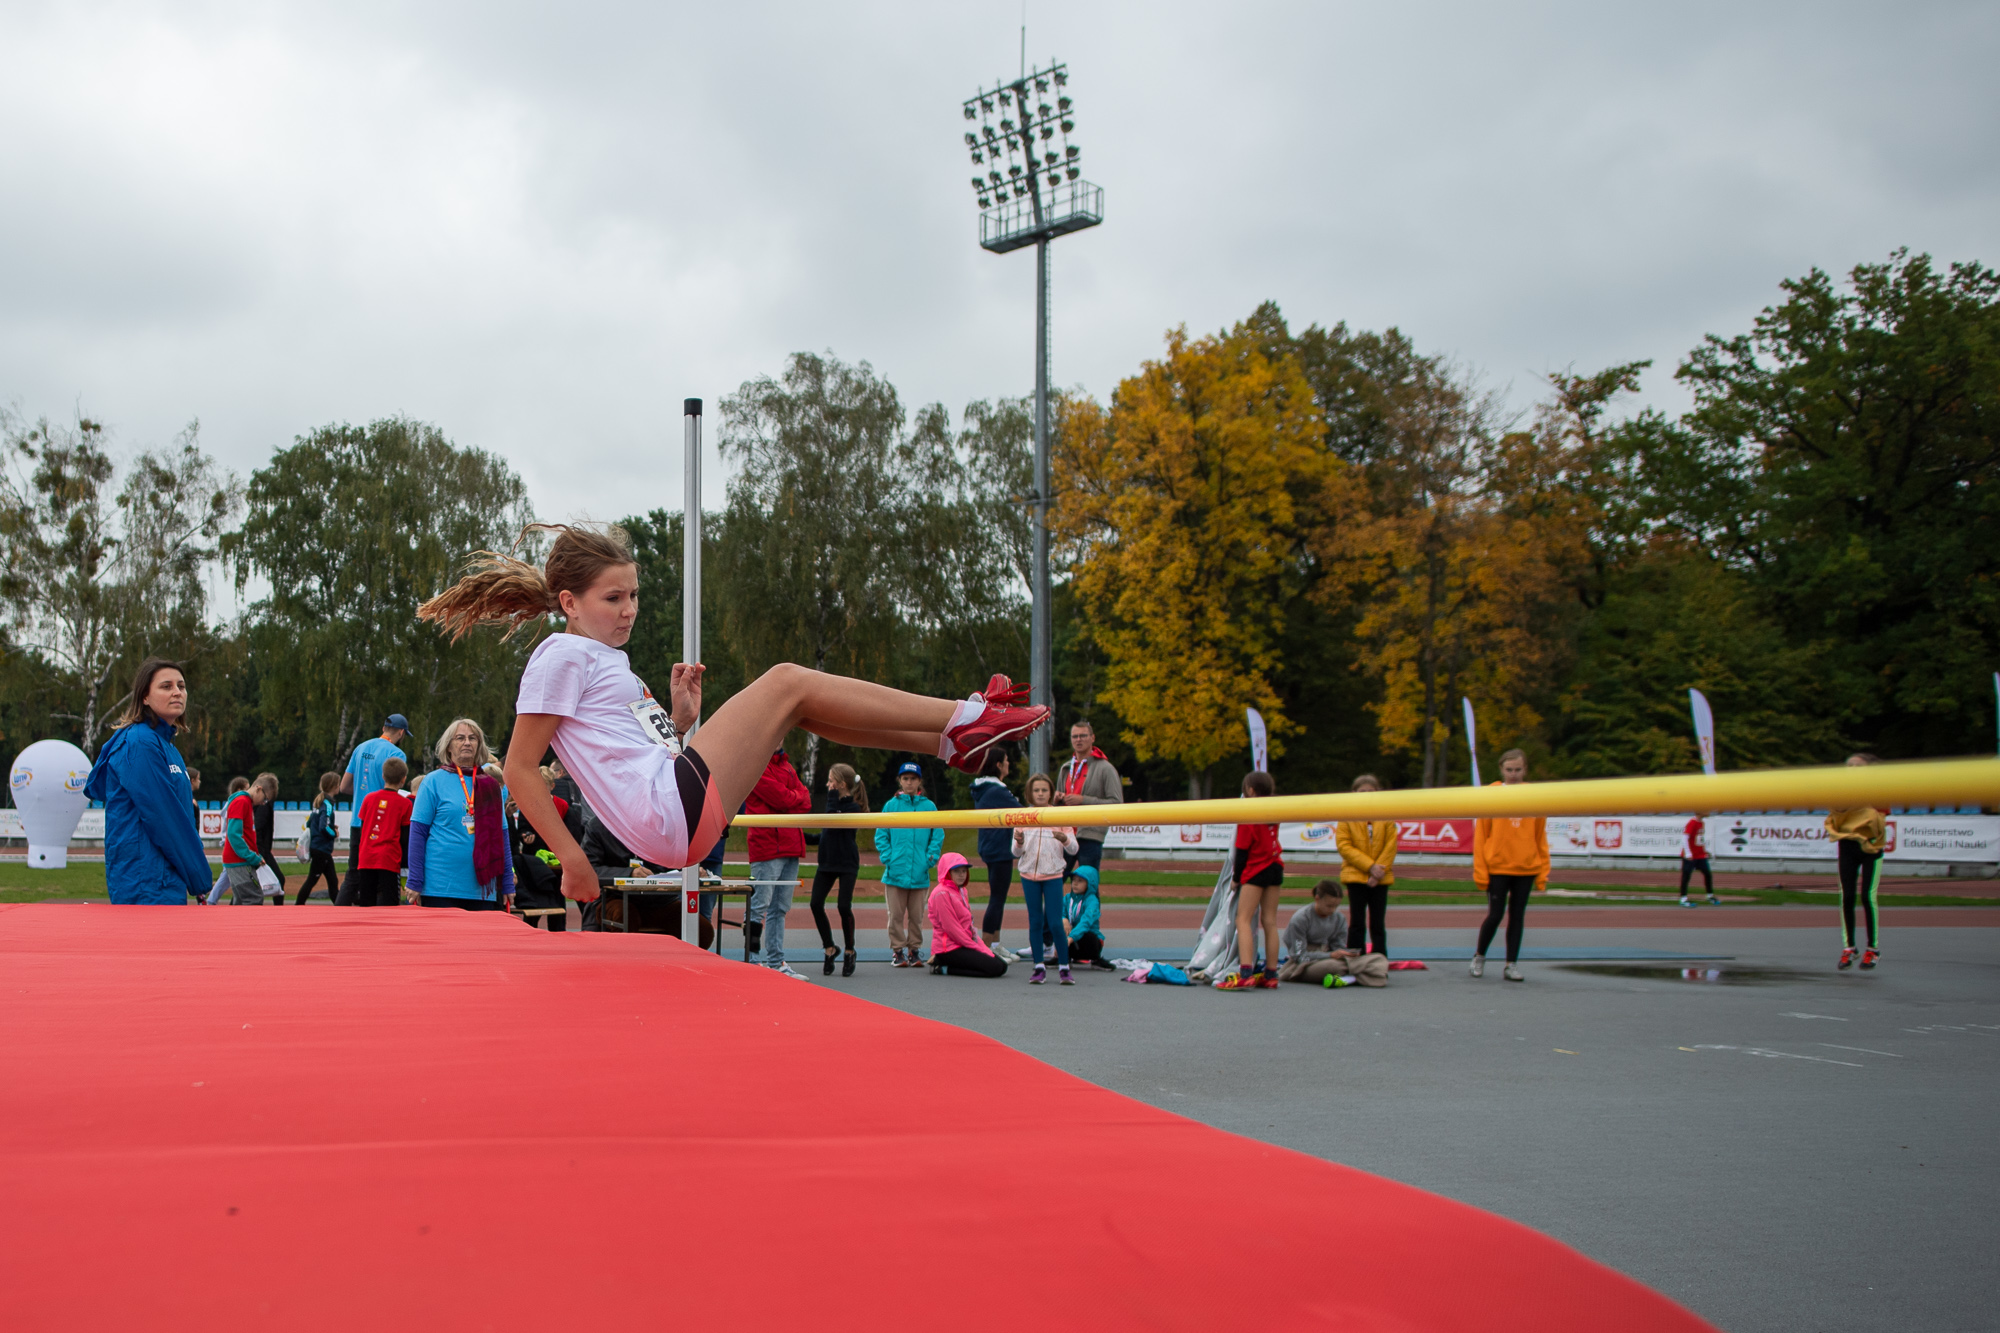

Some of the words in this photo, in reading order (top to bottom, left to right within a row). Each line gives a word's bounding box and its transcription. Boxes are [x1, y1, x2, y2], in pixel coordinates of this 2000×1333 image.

[1109, 825, 1161, 834] UNDACJA
[1903, 827, 1974, 836] Ministerstwo
[1903, 838, 1947, 850] Edukacji
[1954, 839, 1987, 849] Nauki
